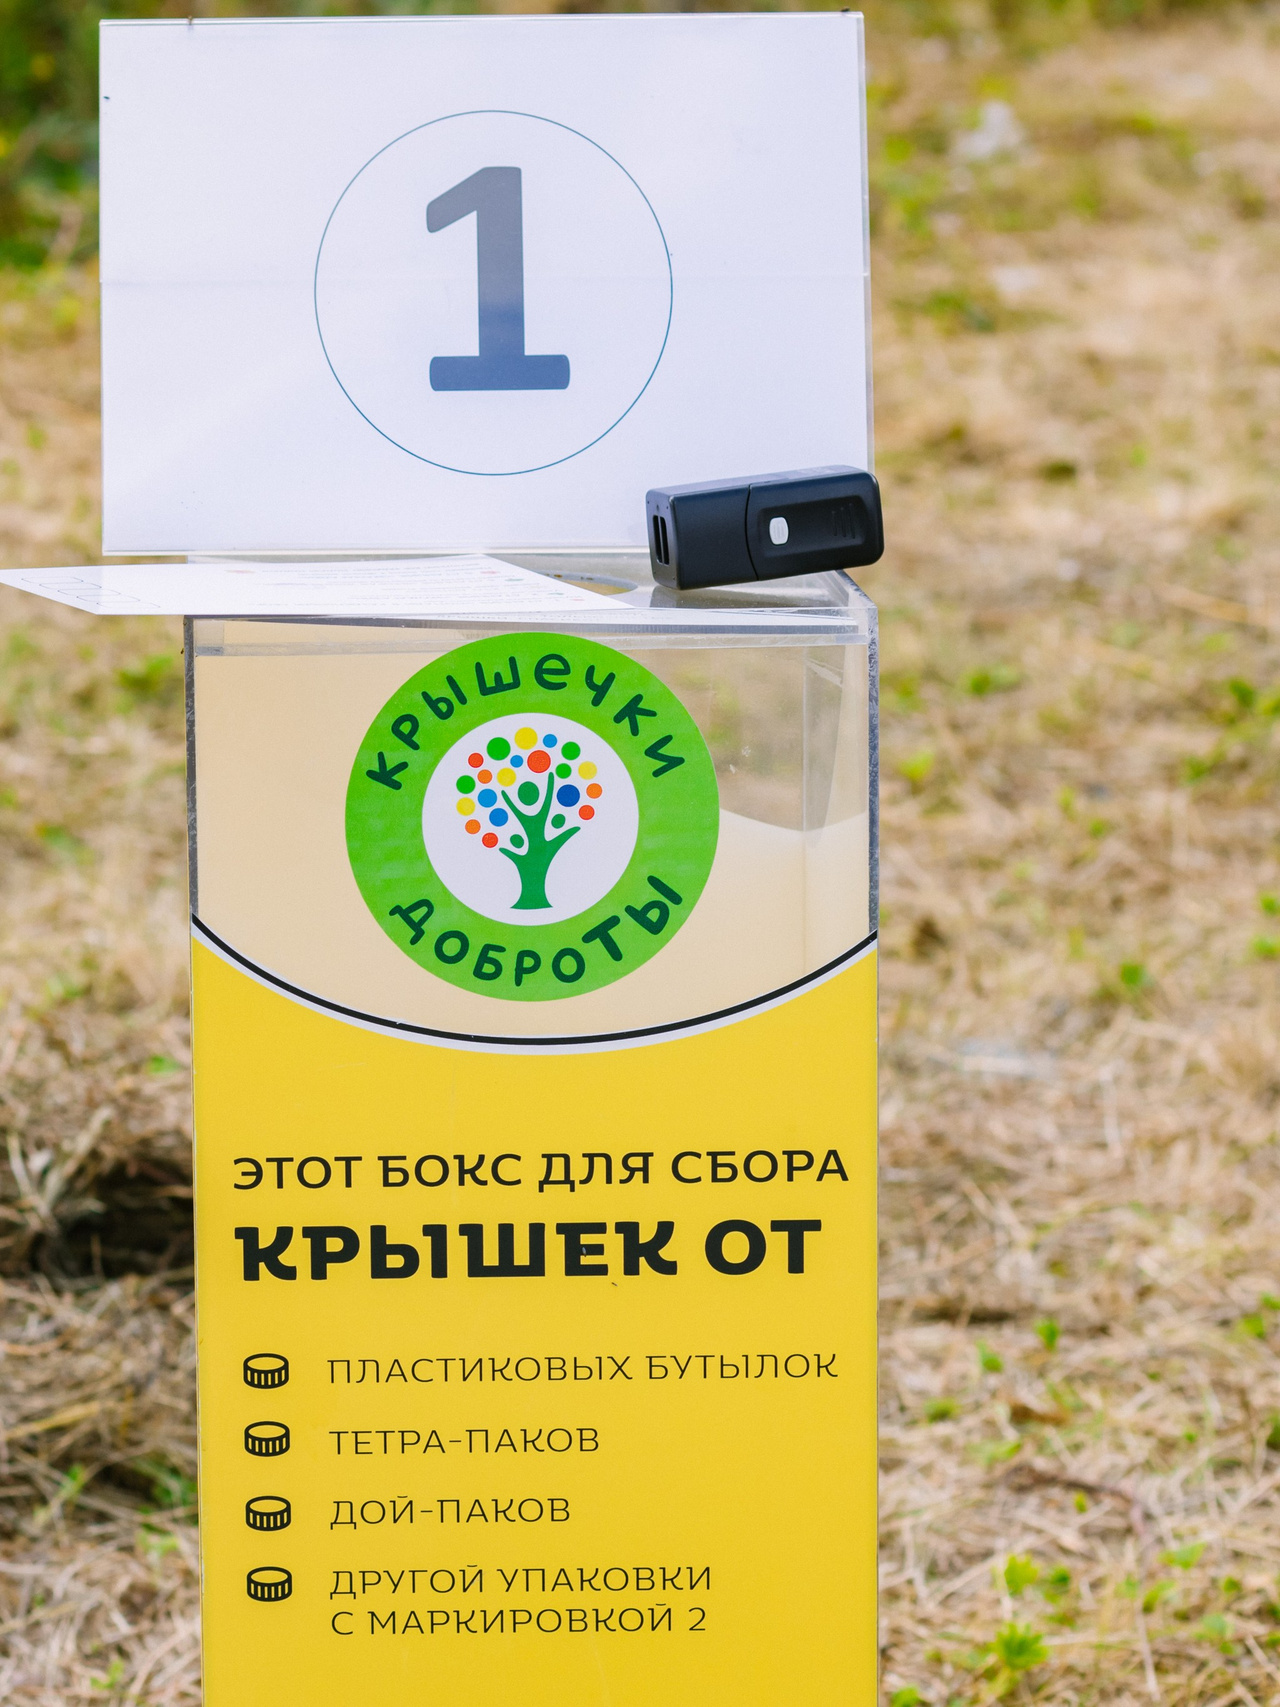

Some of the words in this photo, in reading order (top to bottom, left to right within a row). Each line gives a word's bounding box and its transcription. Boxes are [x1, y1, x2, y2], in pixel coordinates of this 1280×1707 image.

[424, 165, 571, 391] 1
[387, 874, 683, 986] ДОБРОТЫ
[232, 1154, 363, 1190] ЭТОТ
[376, 1152, 522, 1187] БОКС
[537, 1150, 655, 1193] ДЛЯ
[670, 1148, 849, 1183] СБОРА
[232, 1219, 678, 1281] КРЫШЕК
[703, 1217, 823, 1275] ОТ
[326, 1354, 633, 1383] ПЛАСТИКОВЫХ
[644, 1352, 838, 1379] БУТЫЛОК
[328, 1426, 599, 1455] ТЕТРА-ПАКОВ
[328, 1494, 570, 1530] ДОЙ-ПАКОВ
[328, 1563, 483, 1600] ДРУГОЙ
[495, 1565, 711, 1592] УПАКОВКИ
[330, 1610, 354, 1635] С
[366, 1602, 672, 1634] МАРКИРОВКОЙ
[687, 1605, 706, 1631] 2
